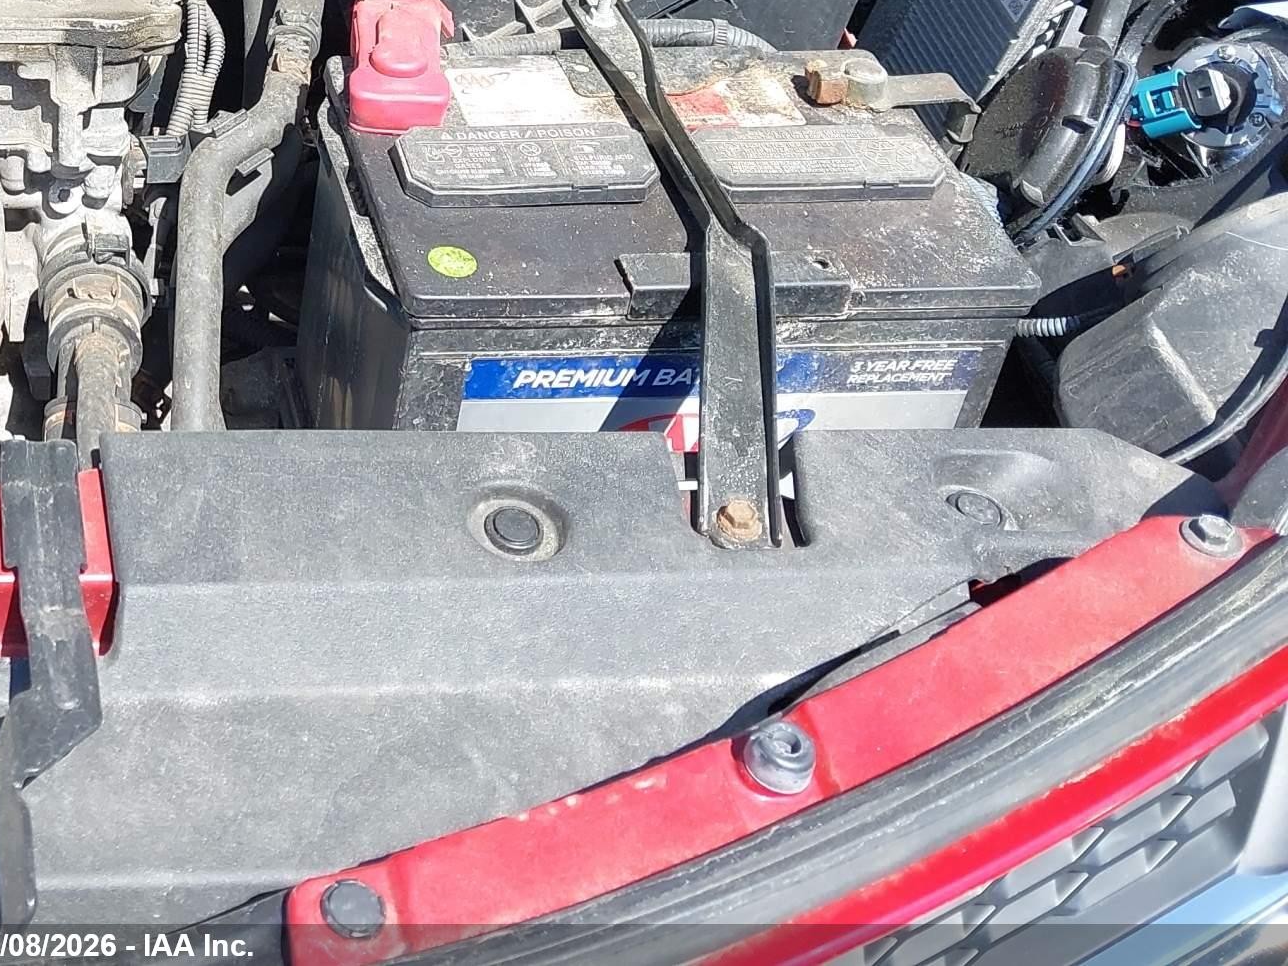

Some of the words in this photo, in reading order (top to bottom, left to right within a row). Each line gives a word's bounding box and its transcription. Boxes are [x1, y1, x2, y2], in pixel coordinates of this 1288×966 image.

[456, 130, 521, 140] DANGER
[537, 128, 596, 139] POISON
[850, 360, 863, 373] 3
[866, 359, 912, 373] YEAR
[910, 359, 959, 371] FREE
[513, 368, 651, 389] PREMIUM
